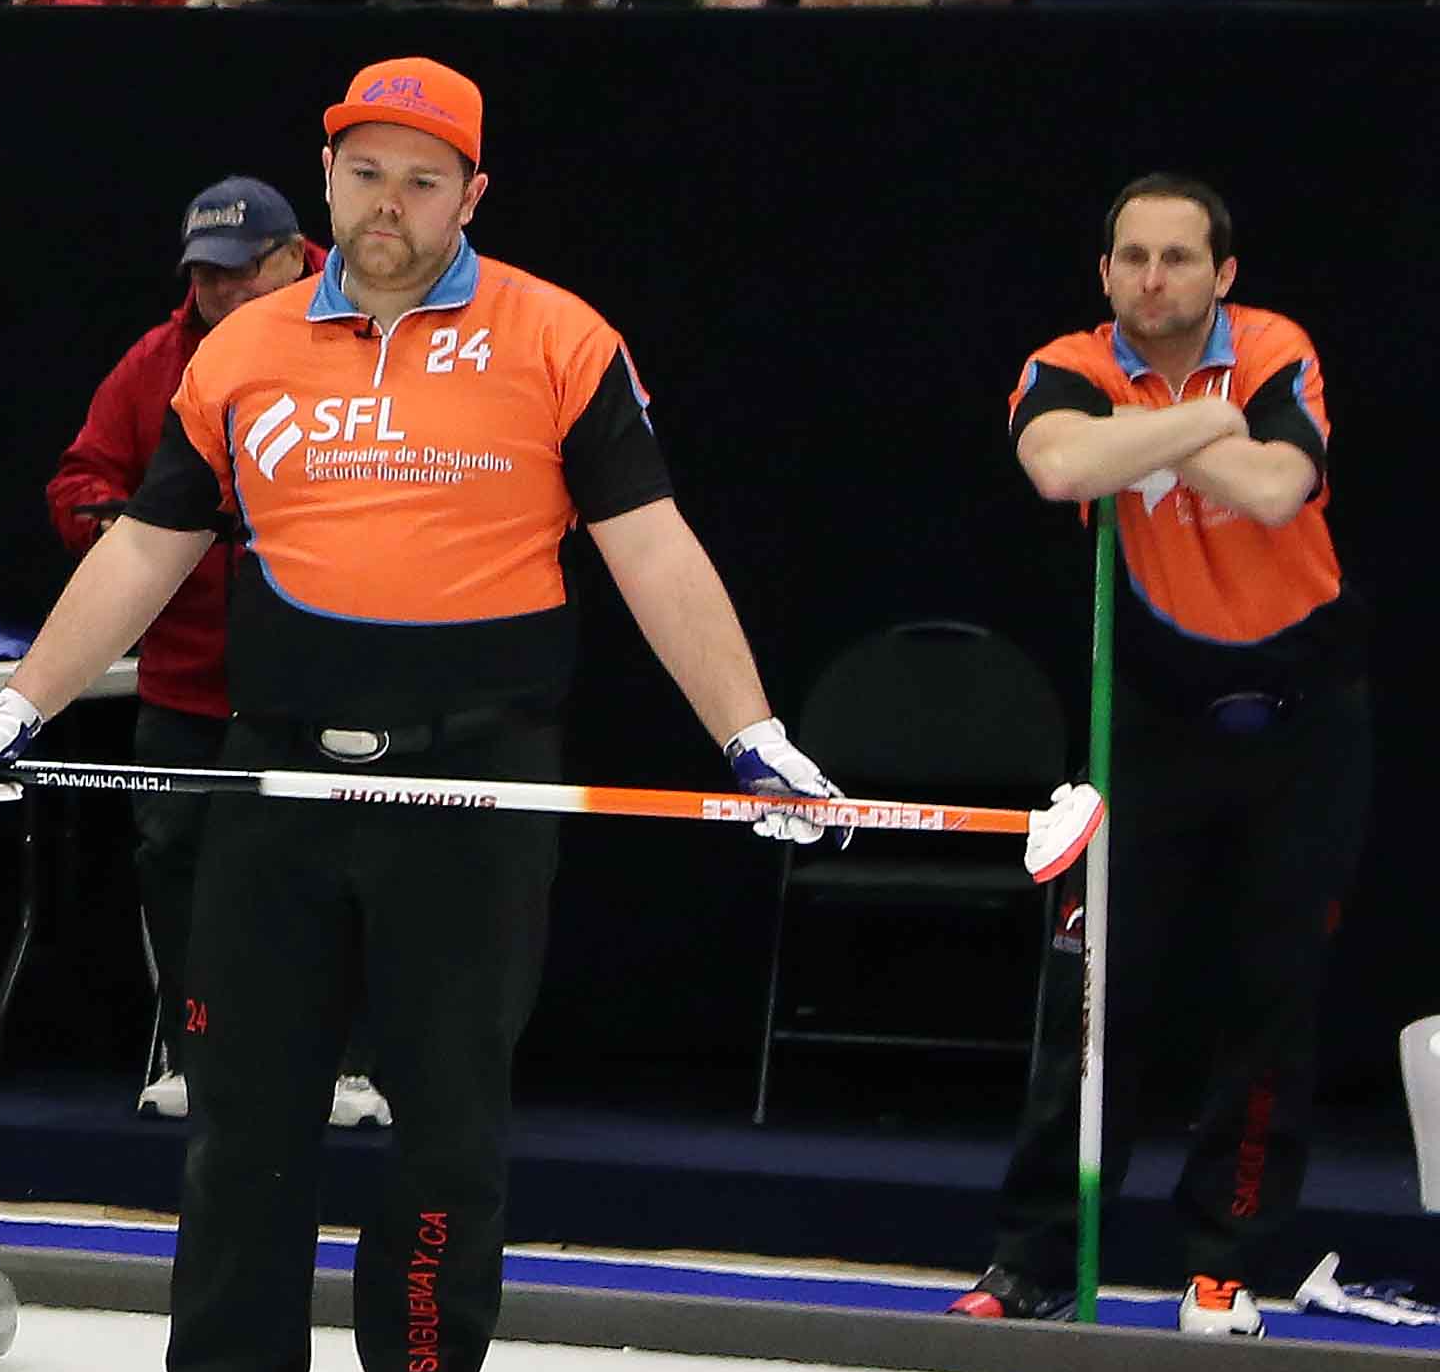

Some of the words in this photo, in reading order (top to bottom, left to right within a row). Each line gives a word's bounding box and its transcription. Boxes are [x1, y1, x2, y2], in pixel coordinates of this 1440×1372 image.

[426, 327, 492, 374] 24
[308, 395, 406, 443] SFL
[394, 445, 417, 464] de
[422, 446, 514, 474] Desjardins
[185, 998, 208, 1034] 24
